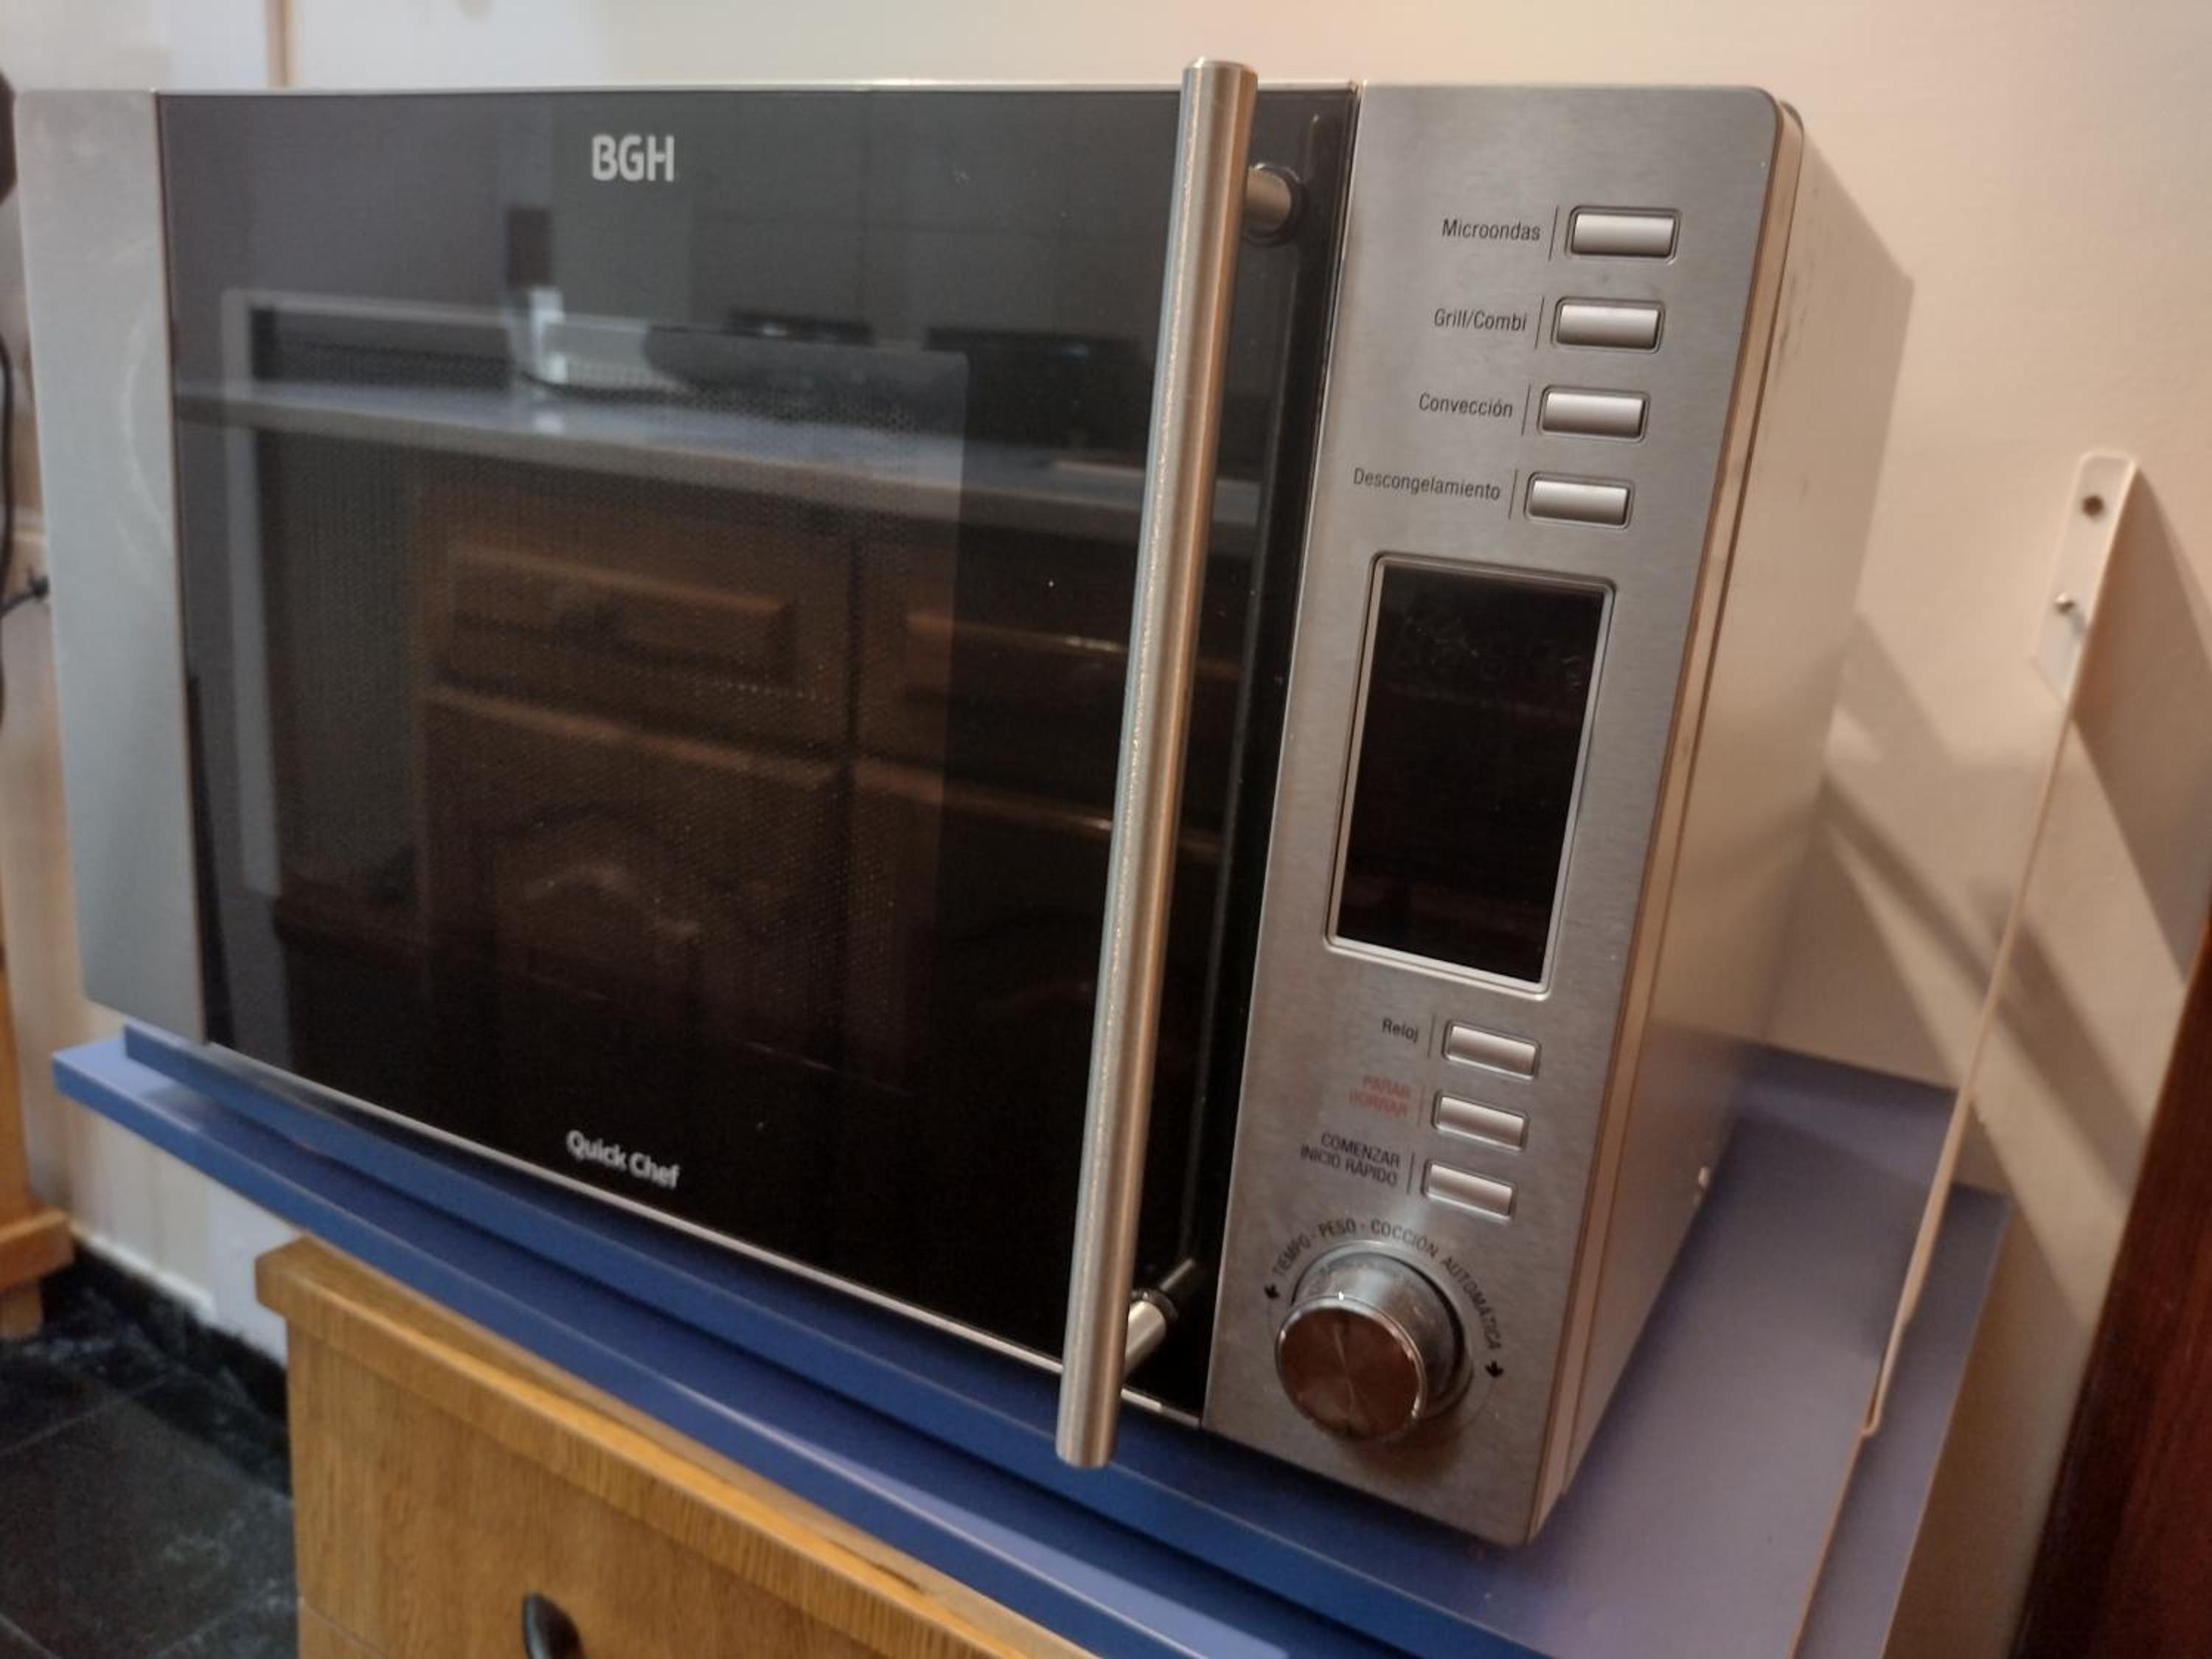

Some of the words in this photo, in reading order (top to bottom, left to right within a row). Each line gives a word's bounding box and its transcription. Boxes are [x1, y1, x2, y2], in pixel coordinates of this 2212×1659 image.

[592, 134, 675, 181] BGH
[1441, 218, 1541, 242] Microondas
[1433, 307, 1528, 331] Grill/Combi
[1419, 392, 1513, 418] Convección
[1353, 467, 1500, 501] Descongelamiento
[1382, 1018, 1419, 1043] Reloj
[566, 1130, 627, 1172] Quick
[628, 1152, 681, 1190] Chef
[1299, 1144, 1341, 1169] INICIO
[1321, 1132, 1399, 1169] COMENZAR
[1318, 1217, 1357, 1239] PESO
